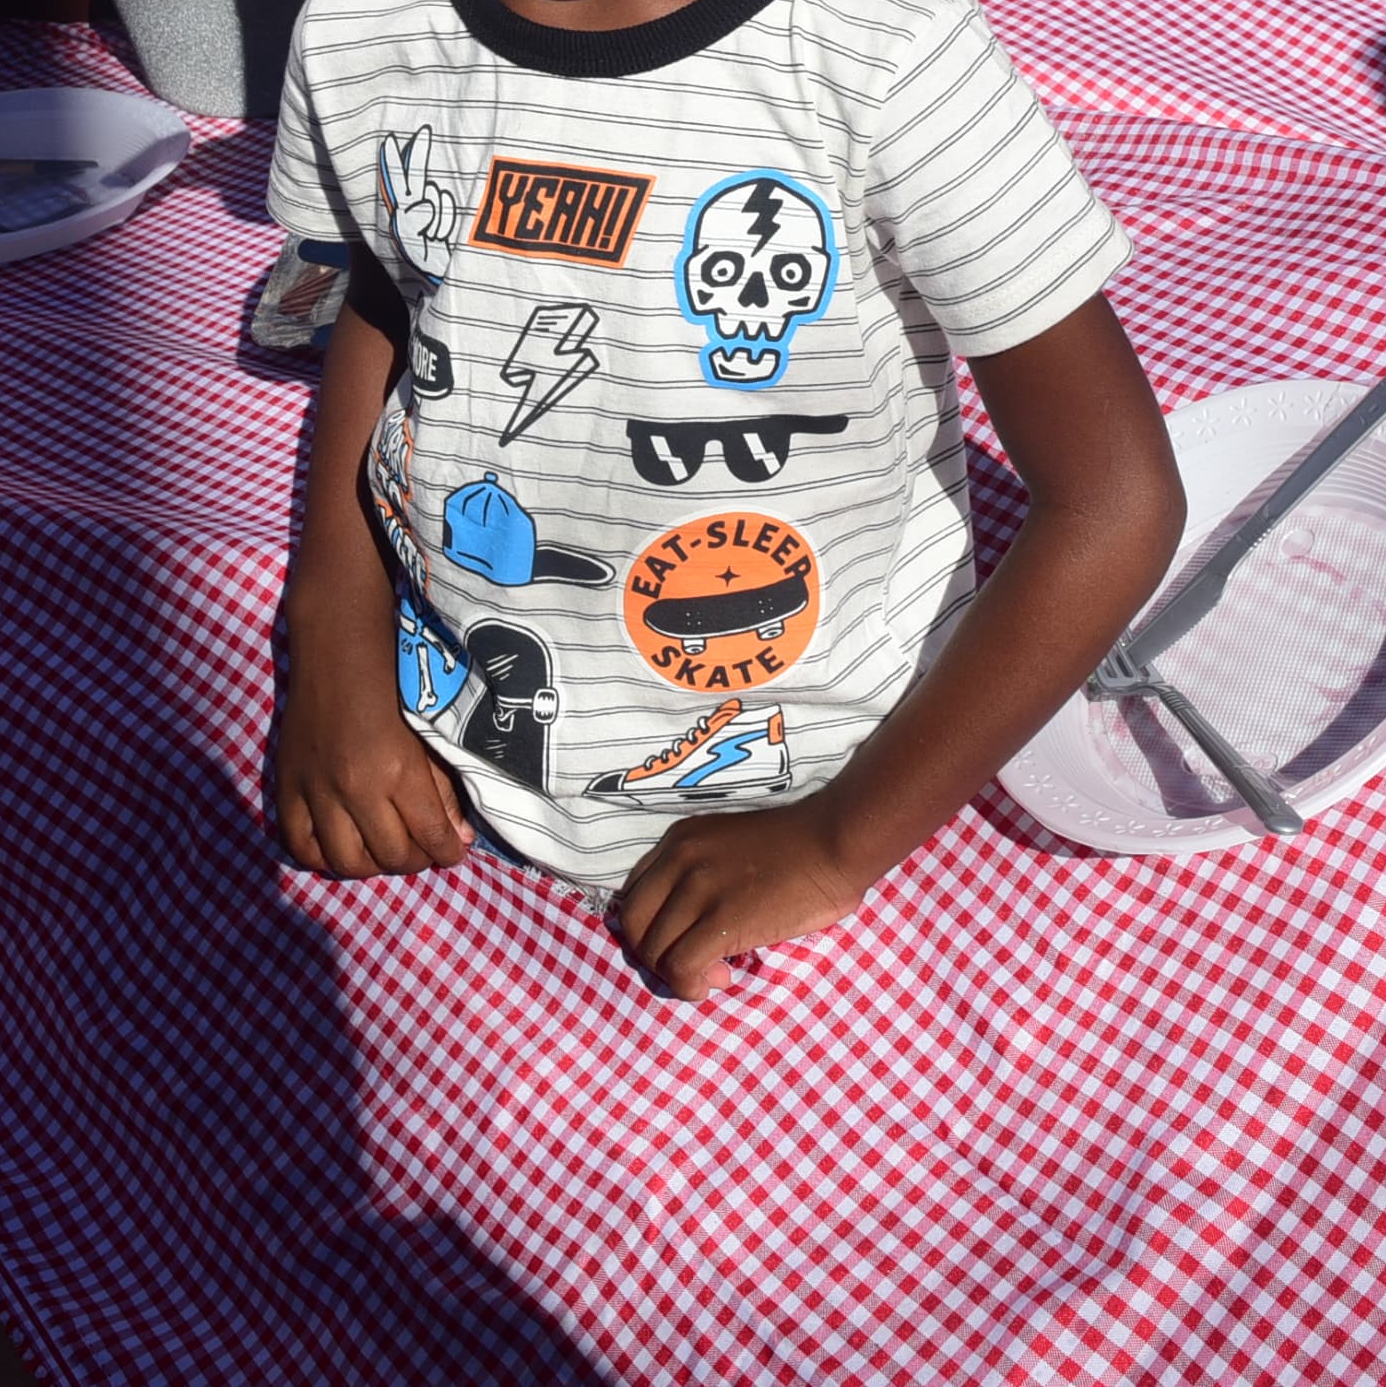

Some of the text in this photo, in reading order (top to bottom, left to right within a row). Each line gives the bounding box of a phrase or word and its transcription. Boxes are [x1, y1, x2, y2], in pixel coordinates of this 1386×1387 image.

[497, 173, 630, 250] YEAH!
[631, 519, 812, 599] EAT-SLEEP
[651, 646, 785, 688] SKATE
